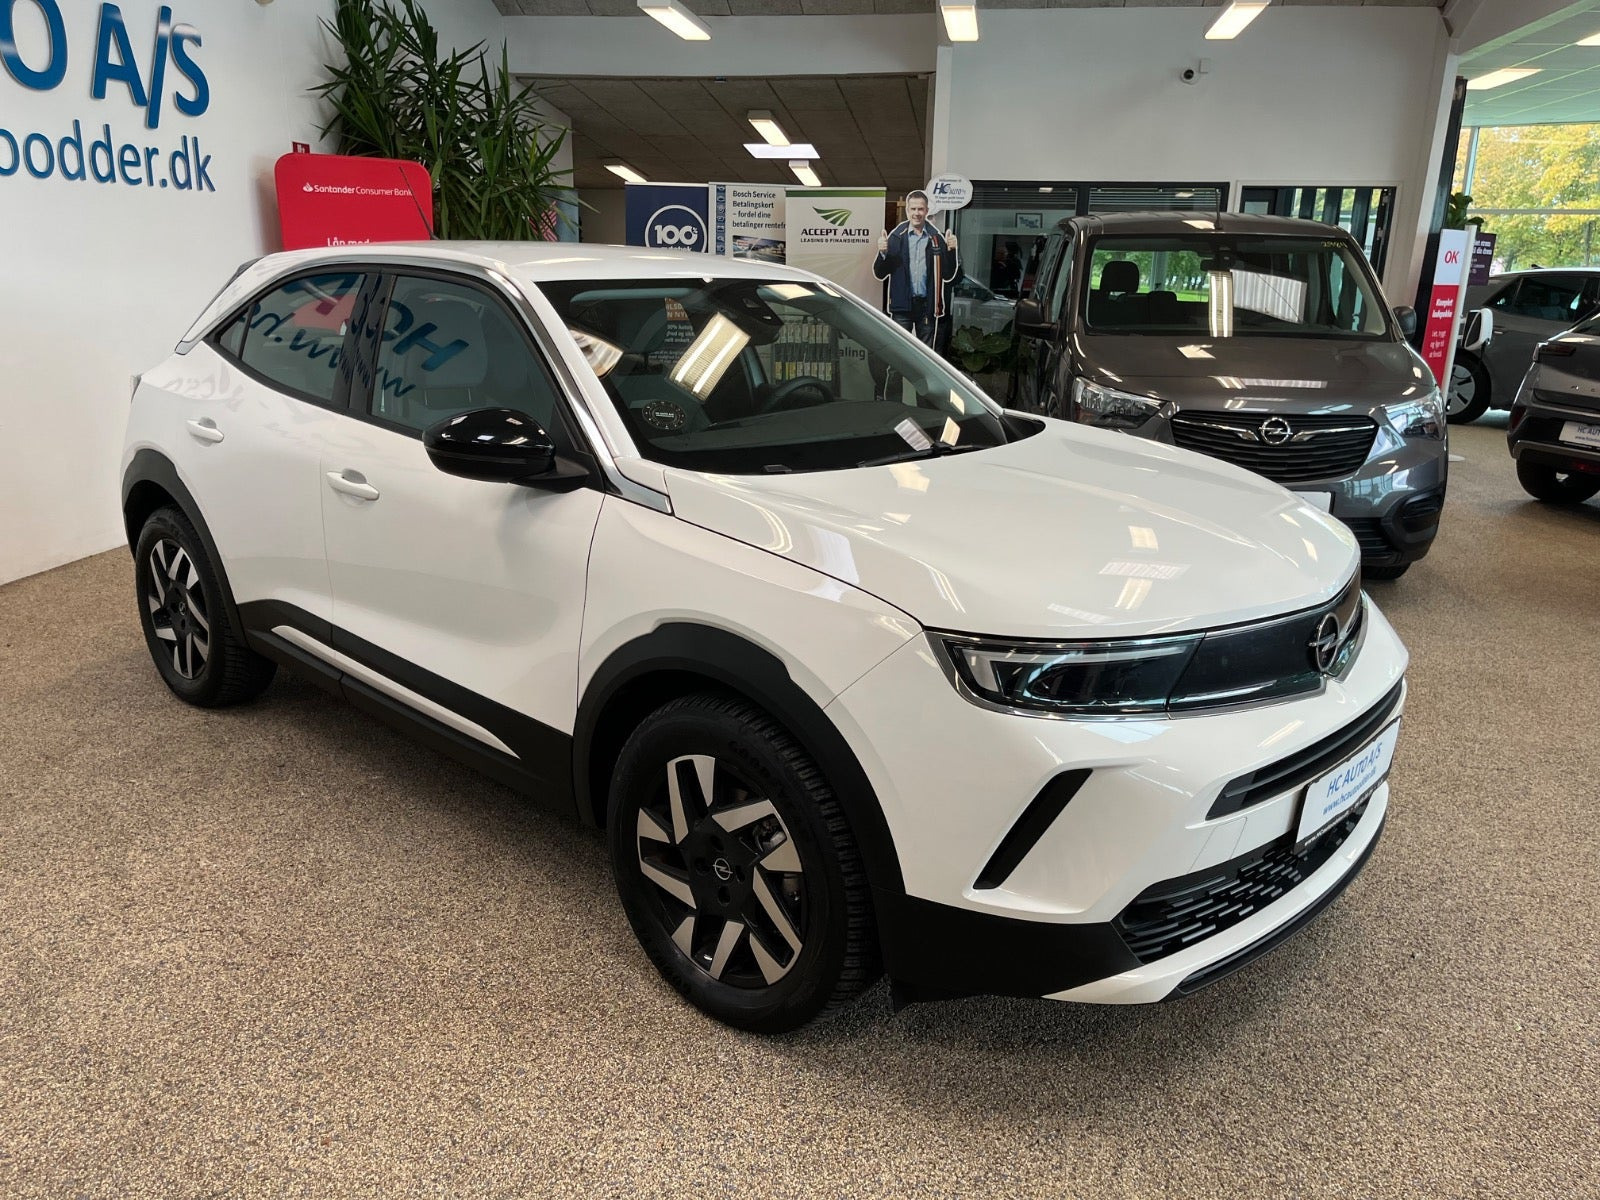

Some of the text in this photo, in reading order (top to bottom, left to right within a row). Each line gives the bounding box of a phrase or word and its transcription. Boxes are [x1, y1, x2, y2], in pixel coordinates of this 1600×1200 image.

[91, 2, 210, 129] A/S
[314, 184, 412, 196] Santander Consumer Bank
[733, 190, 776, 199] Bosch Service
[733, 200, 774, 209] Betalingskort
[738, 210, 756, 218] fordel
[732, 220, 763, 229] betalinger
[801, 228, 869, 236] ACCEPT AUTO
[1445, 250, 1459, 264] OK
[1327, 774, 1342, 798] HC
[1342, 756, 1369, 787] AUTO
[1368, 742, 1383, 767] A/S
